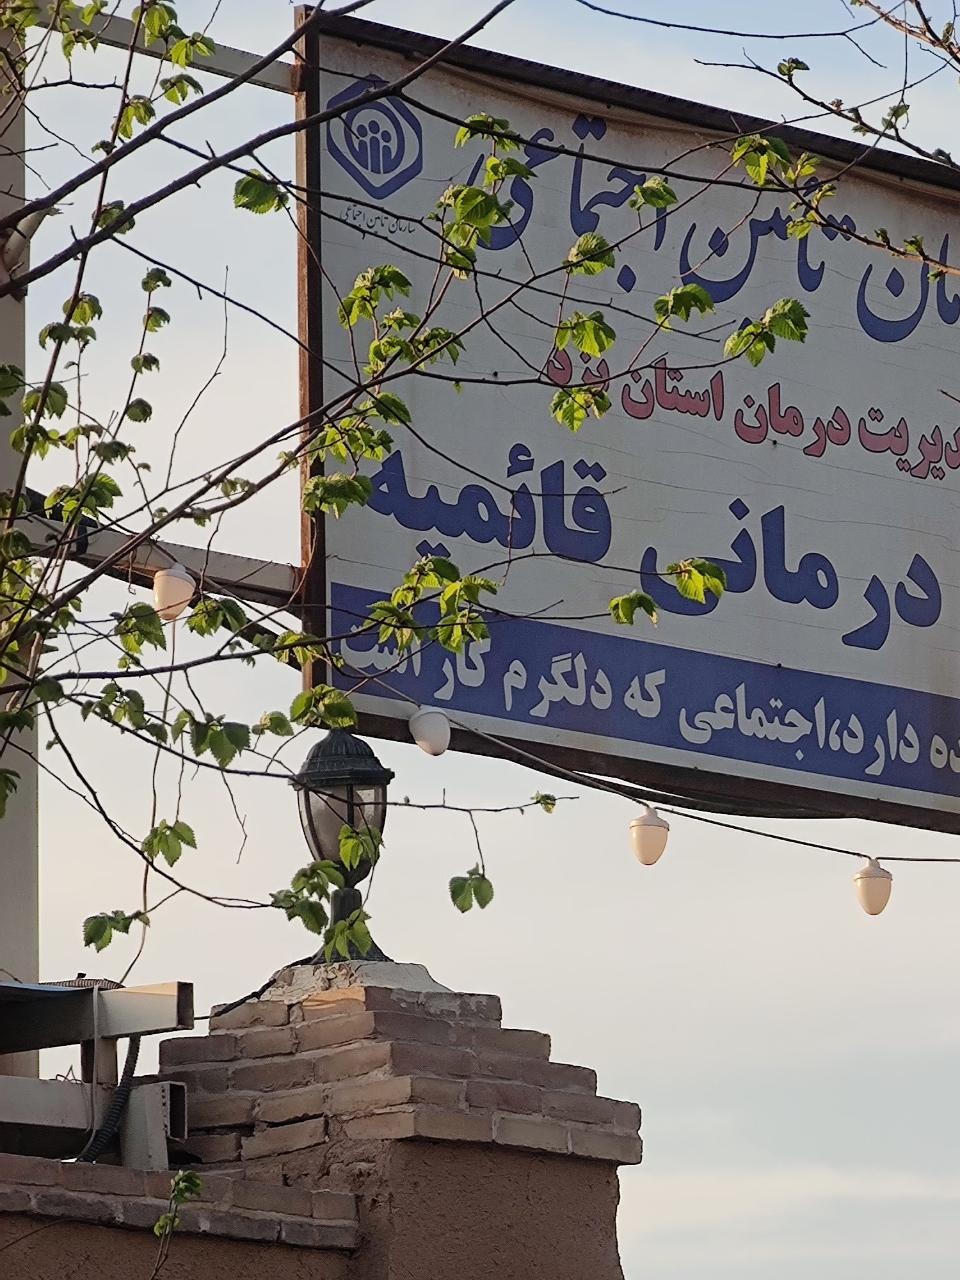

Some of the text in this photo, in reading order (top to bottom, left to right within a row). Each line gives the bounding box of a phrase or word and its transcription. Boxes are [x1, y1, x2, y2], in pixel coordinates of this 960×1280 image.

[620, 357, 725, 422] استان
[733, 382, 852, 458] درمان
[365, 442, 613, 563] قائمیه
[640, 497, 943, 651] درمانی
[623, 668, 667, 718] که
